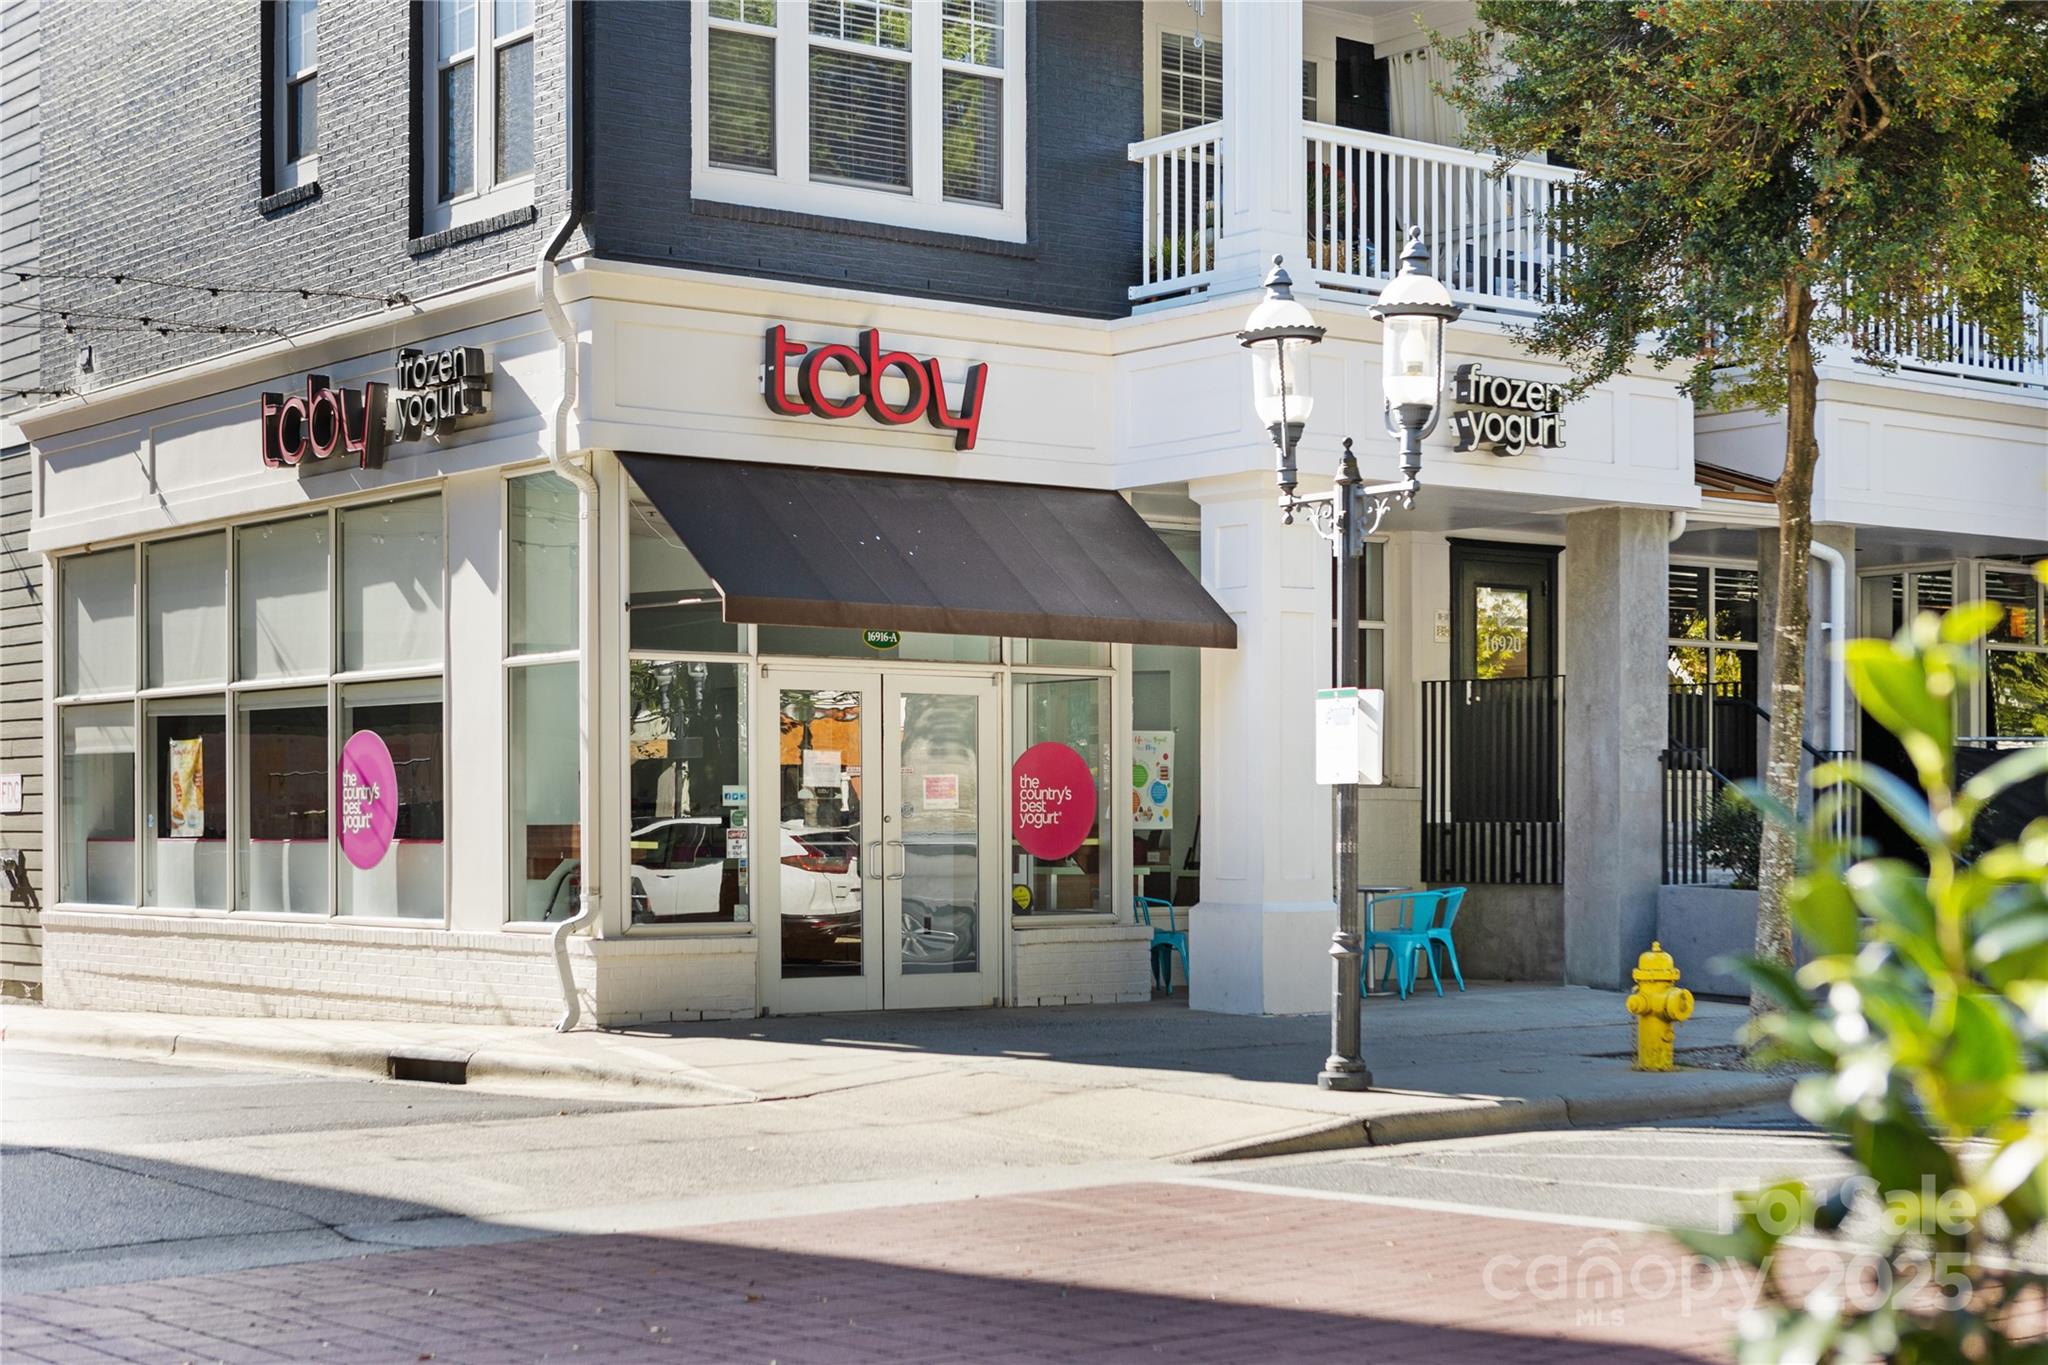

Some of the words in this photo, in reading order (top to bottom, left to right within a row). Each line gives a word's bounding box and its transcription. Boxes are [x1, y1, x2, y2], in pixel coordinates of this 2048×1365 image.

[396, 347, 476, 390] frozen
[764, 324, 988, 450] tcby
[1464, 363, 1564, 413] frozen
[395, 376, 475, 442] yogurt
[262, 374, 382, 470] tcby
[1465, 410, 1566, 456] yogurt
[867, 631, 898, 643] 16916-A
[1484, 635, 1522, 653] 16920
[343, 769, 357, 787] the
[1019, 773, 1040, 789] the
[343, 782, 381, 805] country's
[1019, 786, 1073, 805] country's
[343, 800, 362, 815] best
[1019, 799, 1047, 813] best
